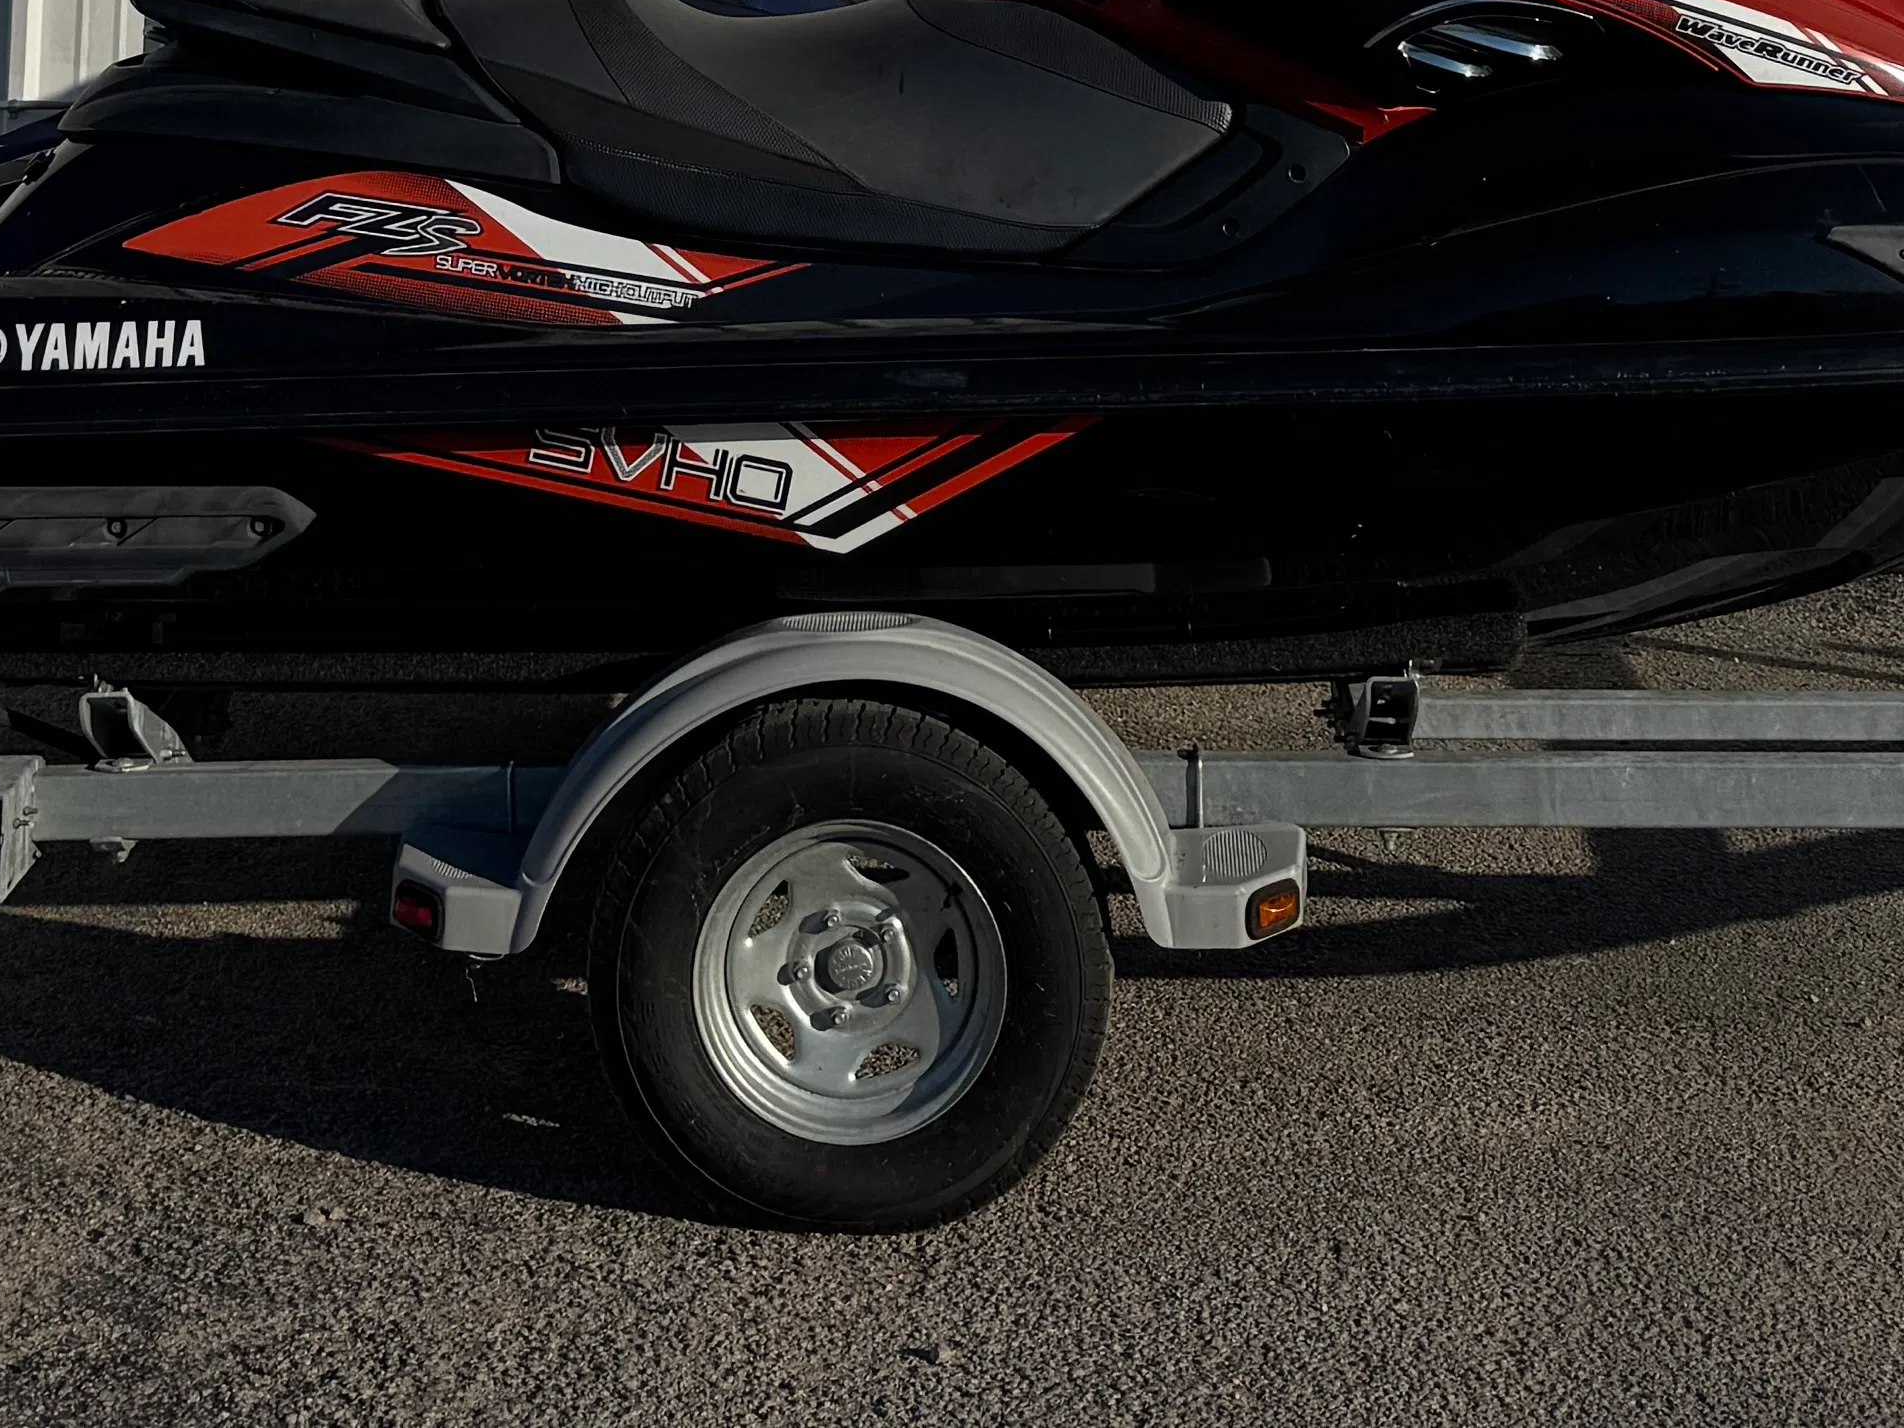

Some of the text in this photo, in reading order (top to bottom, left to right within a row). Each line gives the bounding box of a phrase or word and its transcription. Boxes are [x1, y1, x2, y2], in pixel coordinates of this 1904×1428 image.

[1676, 13, 1864, 85] WaveRunner
[14, 319, 206, 372] YAMAHA
[528, 426, 794, 515] SVHO
